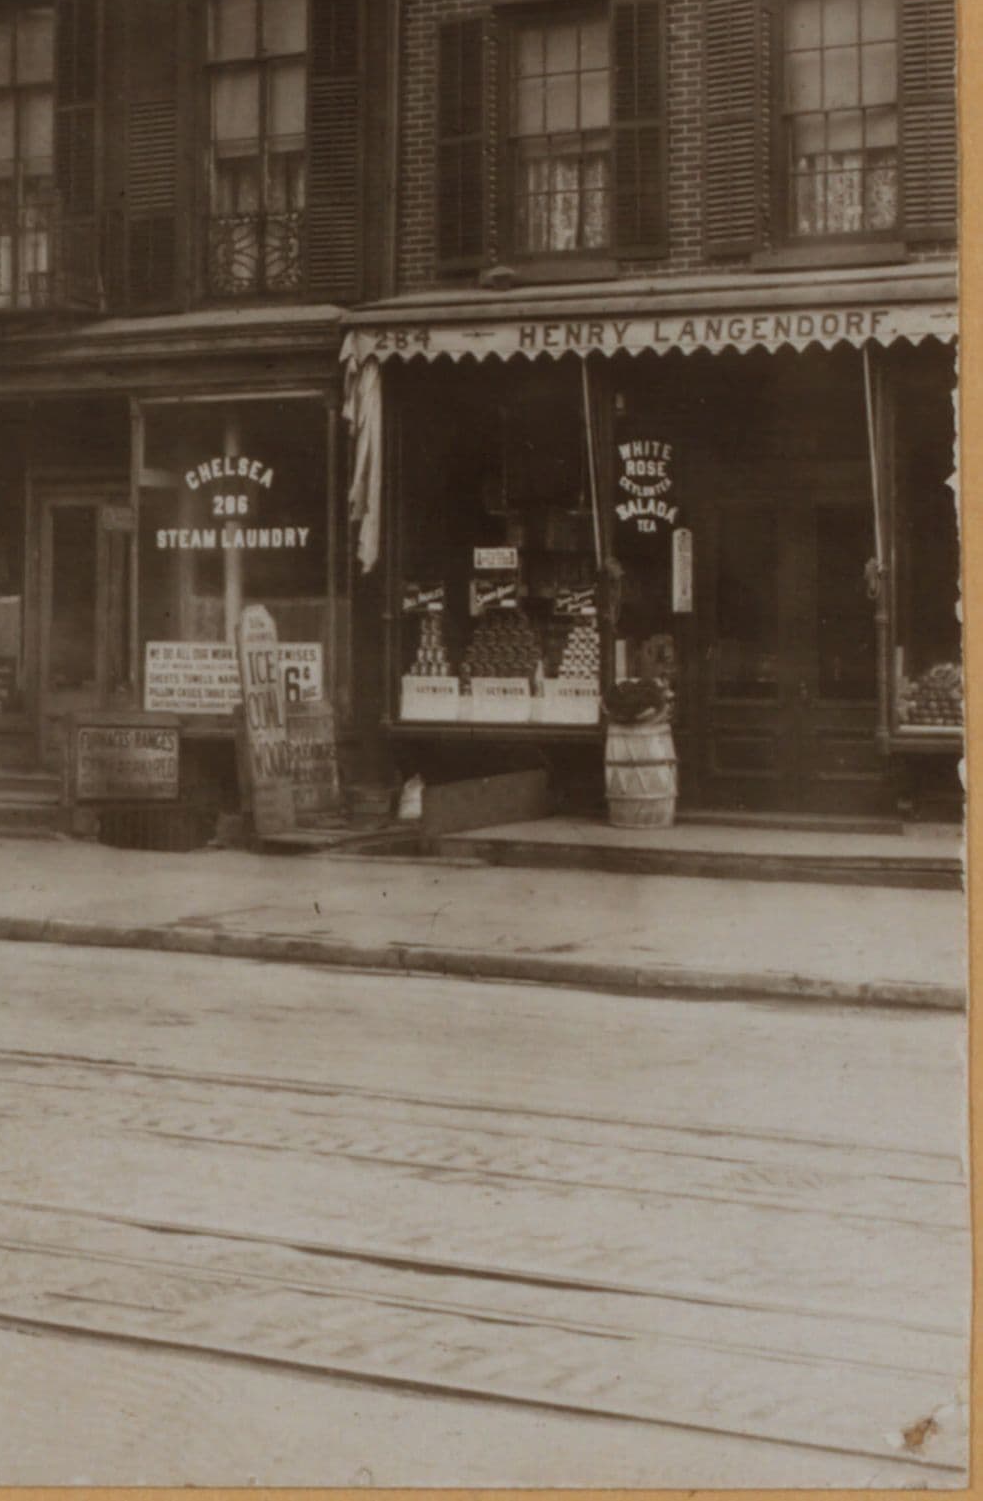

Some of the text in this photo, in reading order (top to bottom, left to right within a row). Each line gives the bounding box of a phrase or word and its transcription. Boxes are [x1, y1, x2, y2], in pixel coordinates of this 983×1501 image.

[374, 330, 432, 350] 284
[519, 321, 632, 348] HENRY
[618, 439, 673, 461] WHITE
[184, 456, 275, 490] CHELSEA
[625, 459, 667, 477] ROSE
[616, 498, 679, 525] SALADA
[156, 526, 310, 549] STEAM LAUNDRY
[636, 519, 657, 533] TEA
[248, 650, 277, 685] ICE
[134, 731, 174, 752] RANGES
